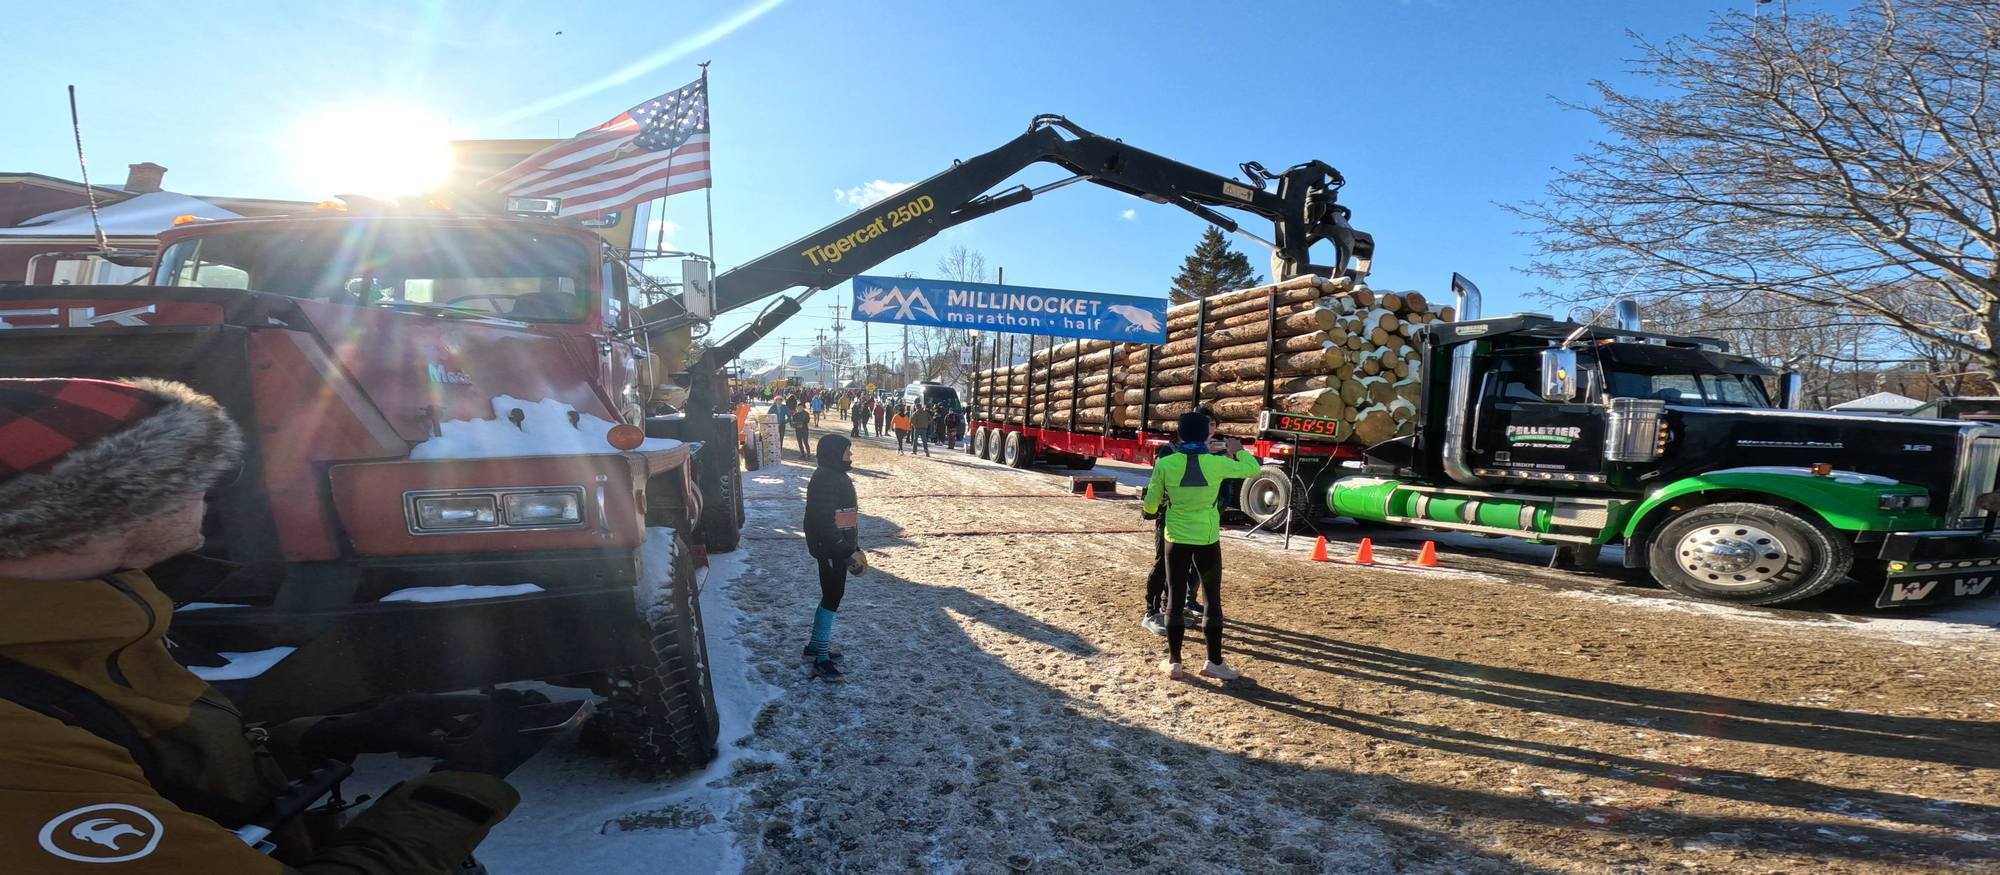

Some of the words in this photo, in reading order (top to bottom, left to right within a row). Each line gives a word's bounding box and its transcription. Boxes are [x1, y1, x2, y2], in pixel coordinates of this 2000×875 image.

[801, 215, 888, 267] Tigercat
[887, 195, 934, 228] 250D
[947, 289, 1102, 316] MILLINOCKET
[947, 311, 1040, 327] marathon
[1064, 316, 1102, 331] half
[1506, 425, 1581, 439] PELLETIER
